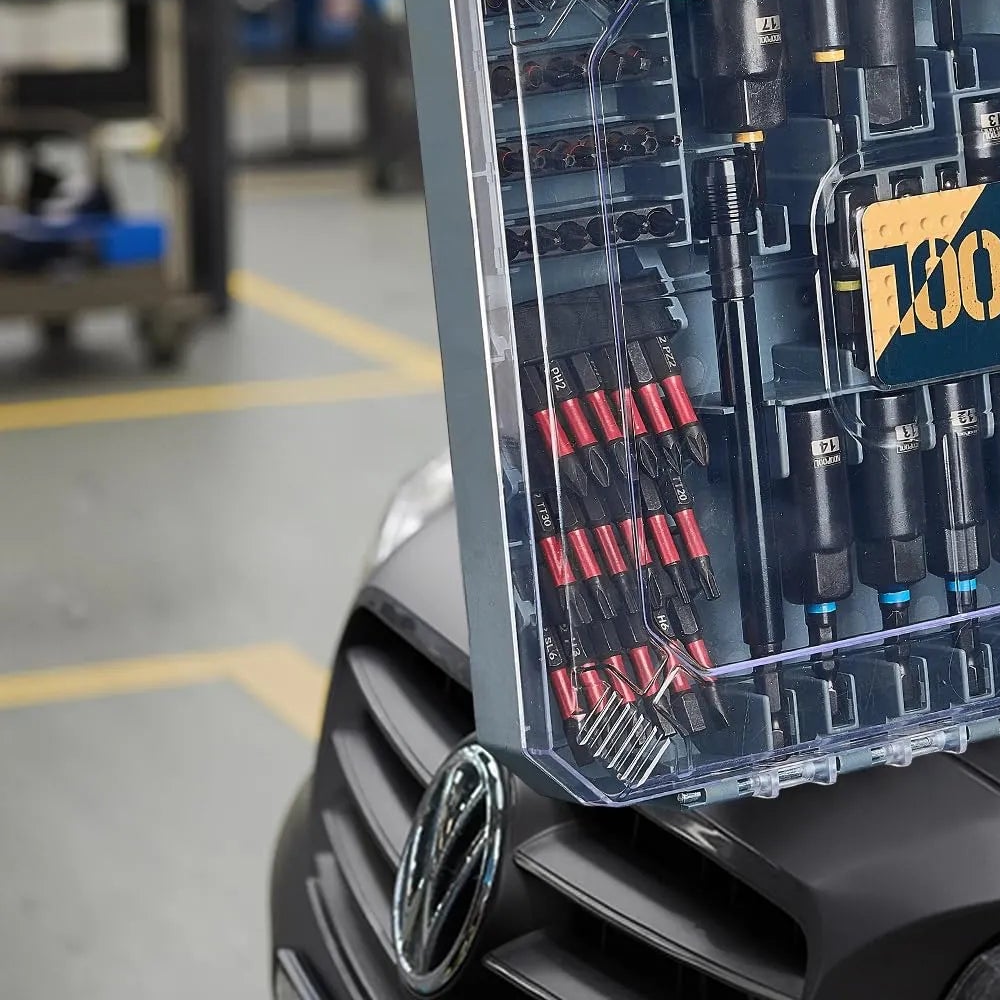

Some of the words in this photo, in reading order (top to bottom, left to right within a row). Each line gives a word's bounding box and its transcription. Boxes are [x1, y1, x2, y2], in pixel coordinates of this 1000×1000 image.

[762, 18, 777, 30] 17
[662, 346, 676, 368] PZ2
[550, 367, 567, 391] PH2
[820, 439, 836, 452] 14
[672, 476, 688, 501] TT20
[536, 502, 552, 526] TT30
[657, 615, 669, 631] H6
[545, 637, 557, 660] SL6
